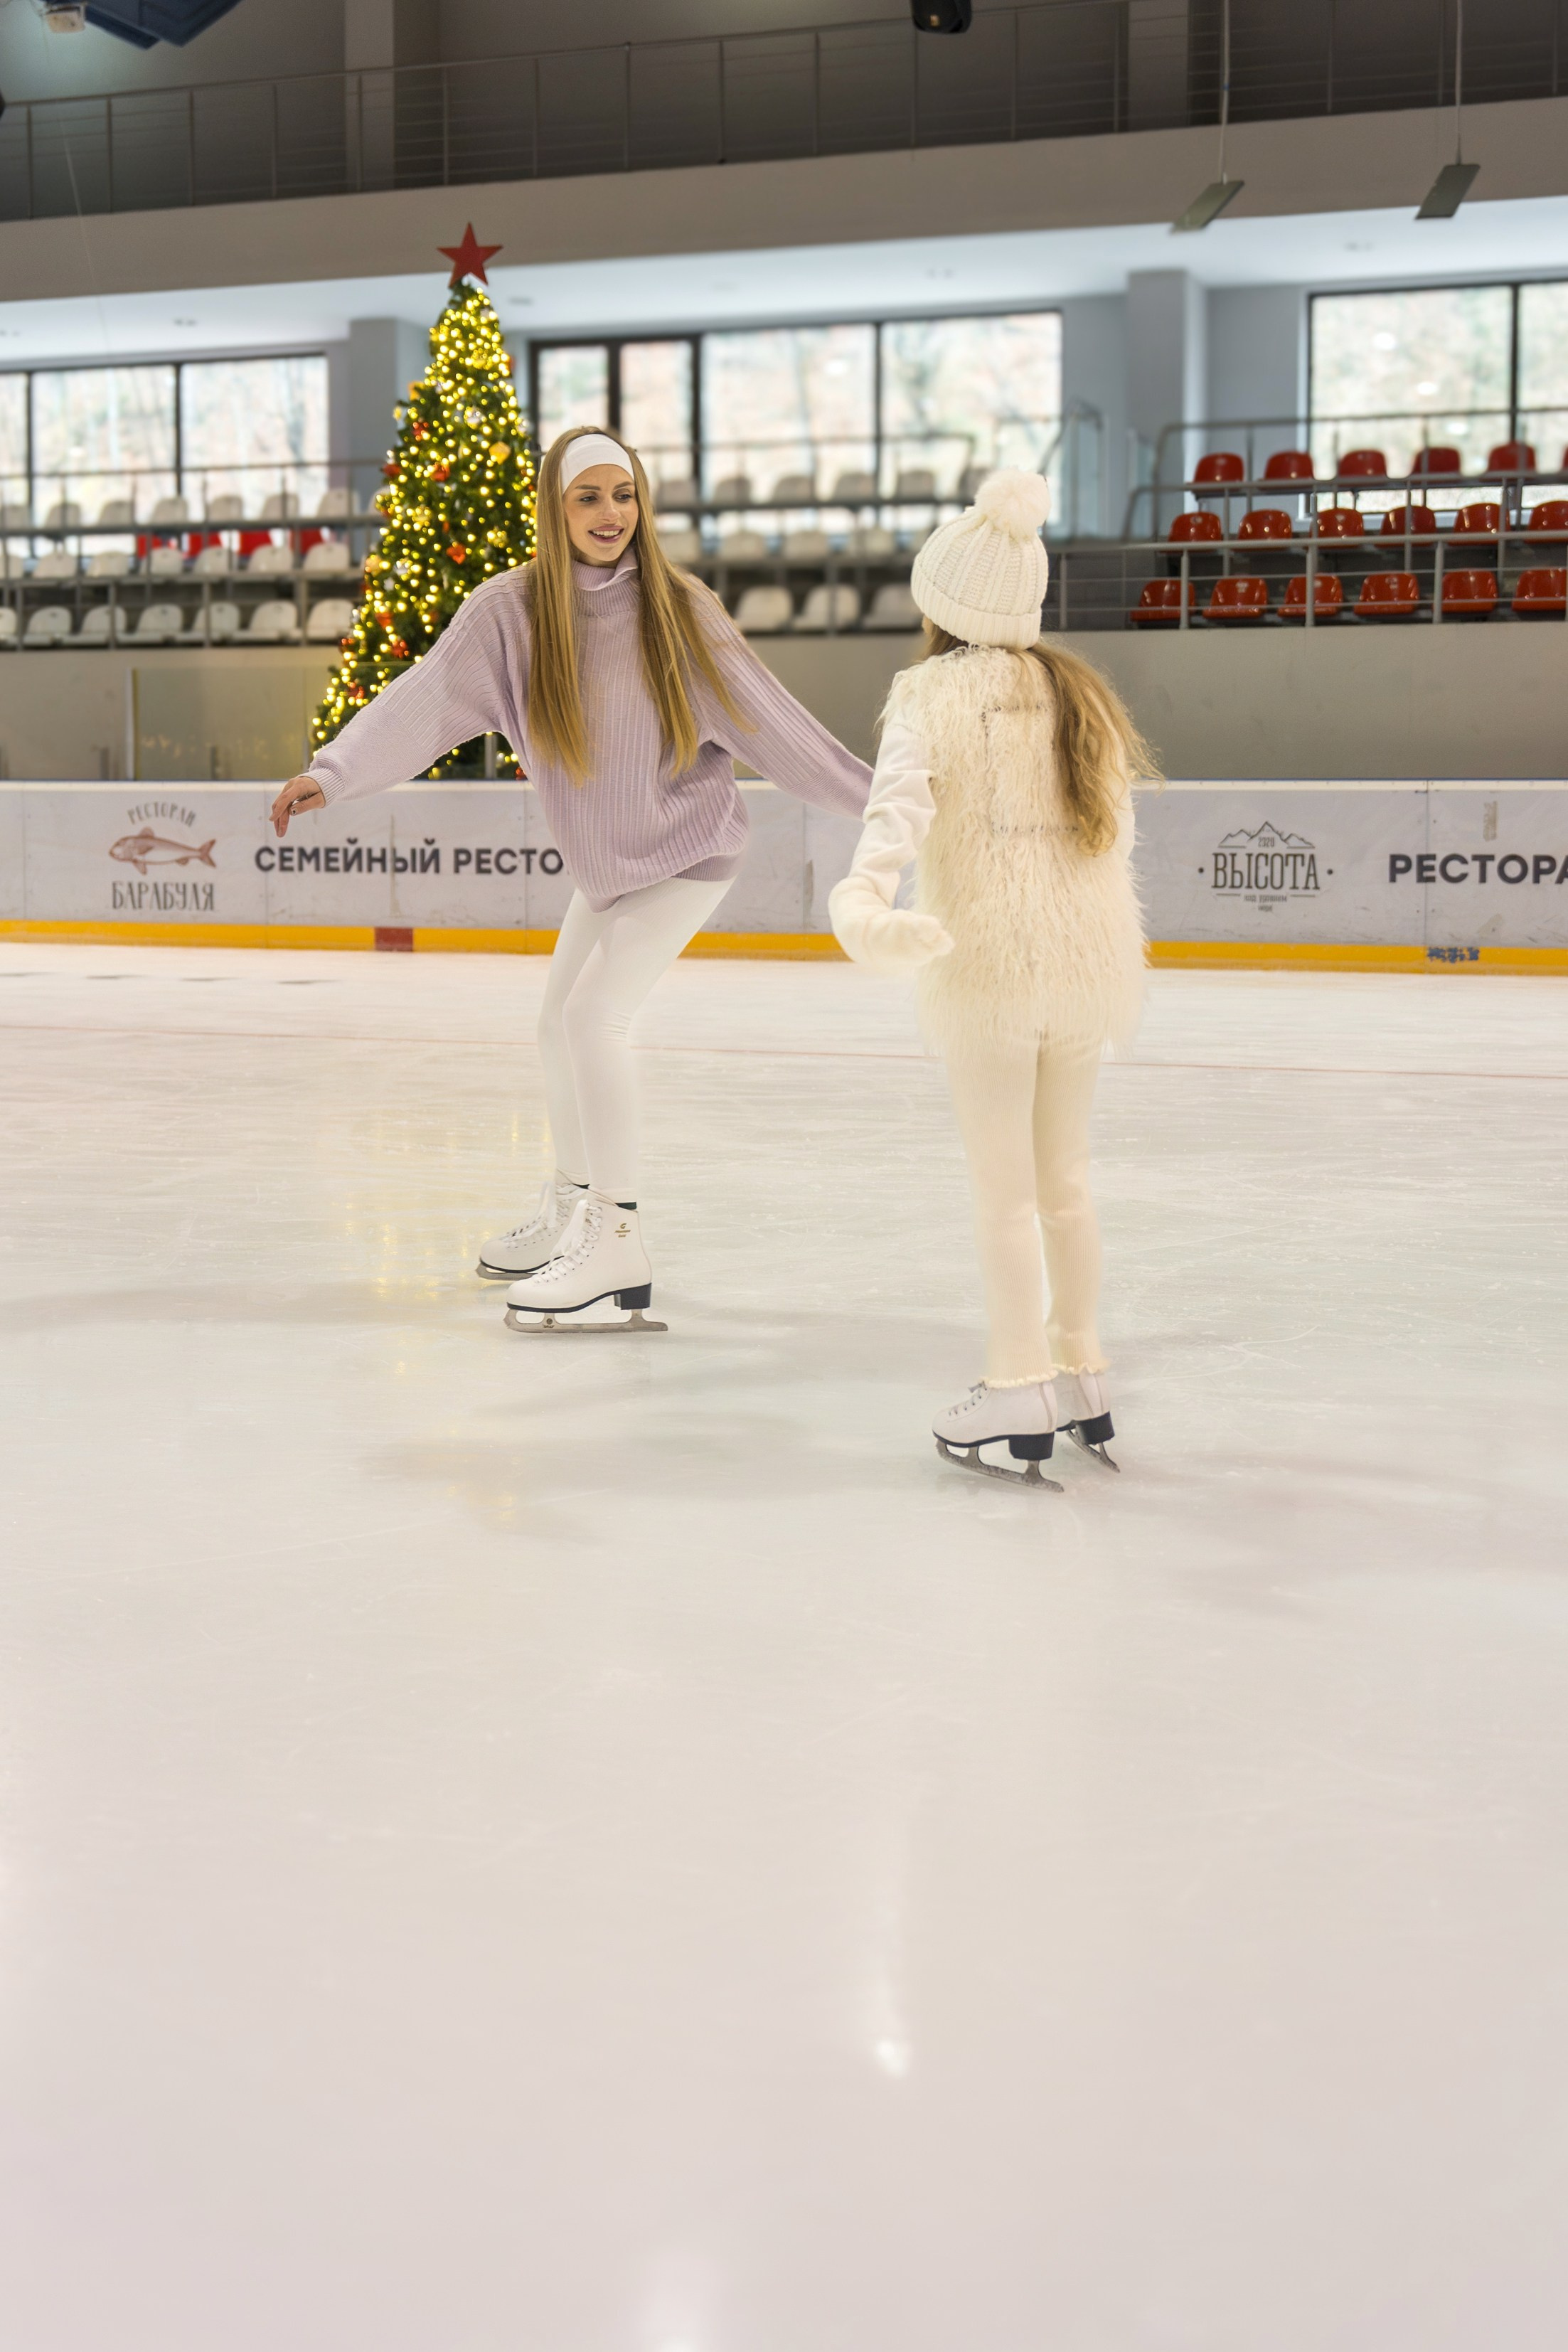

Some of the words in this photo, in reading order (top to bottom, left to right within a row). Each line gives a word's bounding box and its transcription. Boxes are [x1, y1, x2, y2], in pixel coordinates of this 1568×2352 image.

[255, 837, 440, 873] СЕМЕЙНЫЙ
[454, 848, 569, 875] РЕСТО
[1211, 853, 1321, 890] ВЫСОТА
[112, 881, 215, 911] БАРАБУЛЯ
